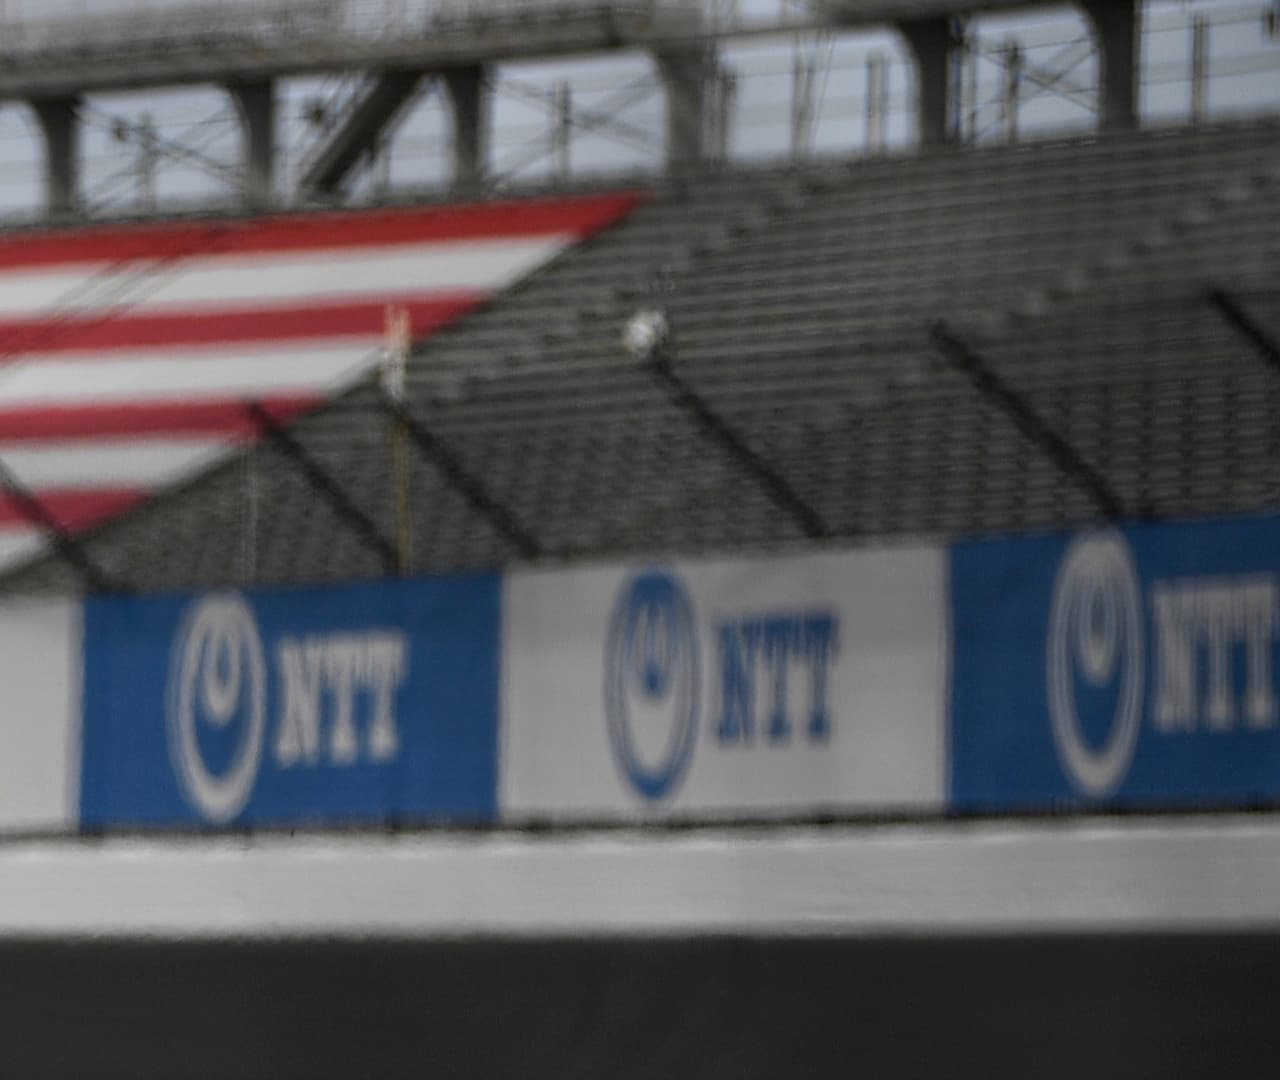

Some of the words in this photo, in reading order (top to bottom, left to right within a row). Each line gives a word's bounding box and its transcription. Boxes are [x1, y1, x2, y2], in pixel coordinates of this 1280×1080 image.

[275, 630, 408, 766] NTT
[712, 609, 841, 747] NTT
[1153, 578, 1280, 730] NTT
